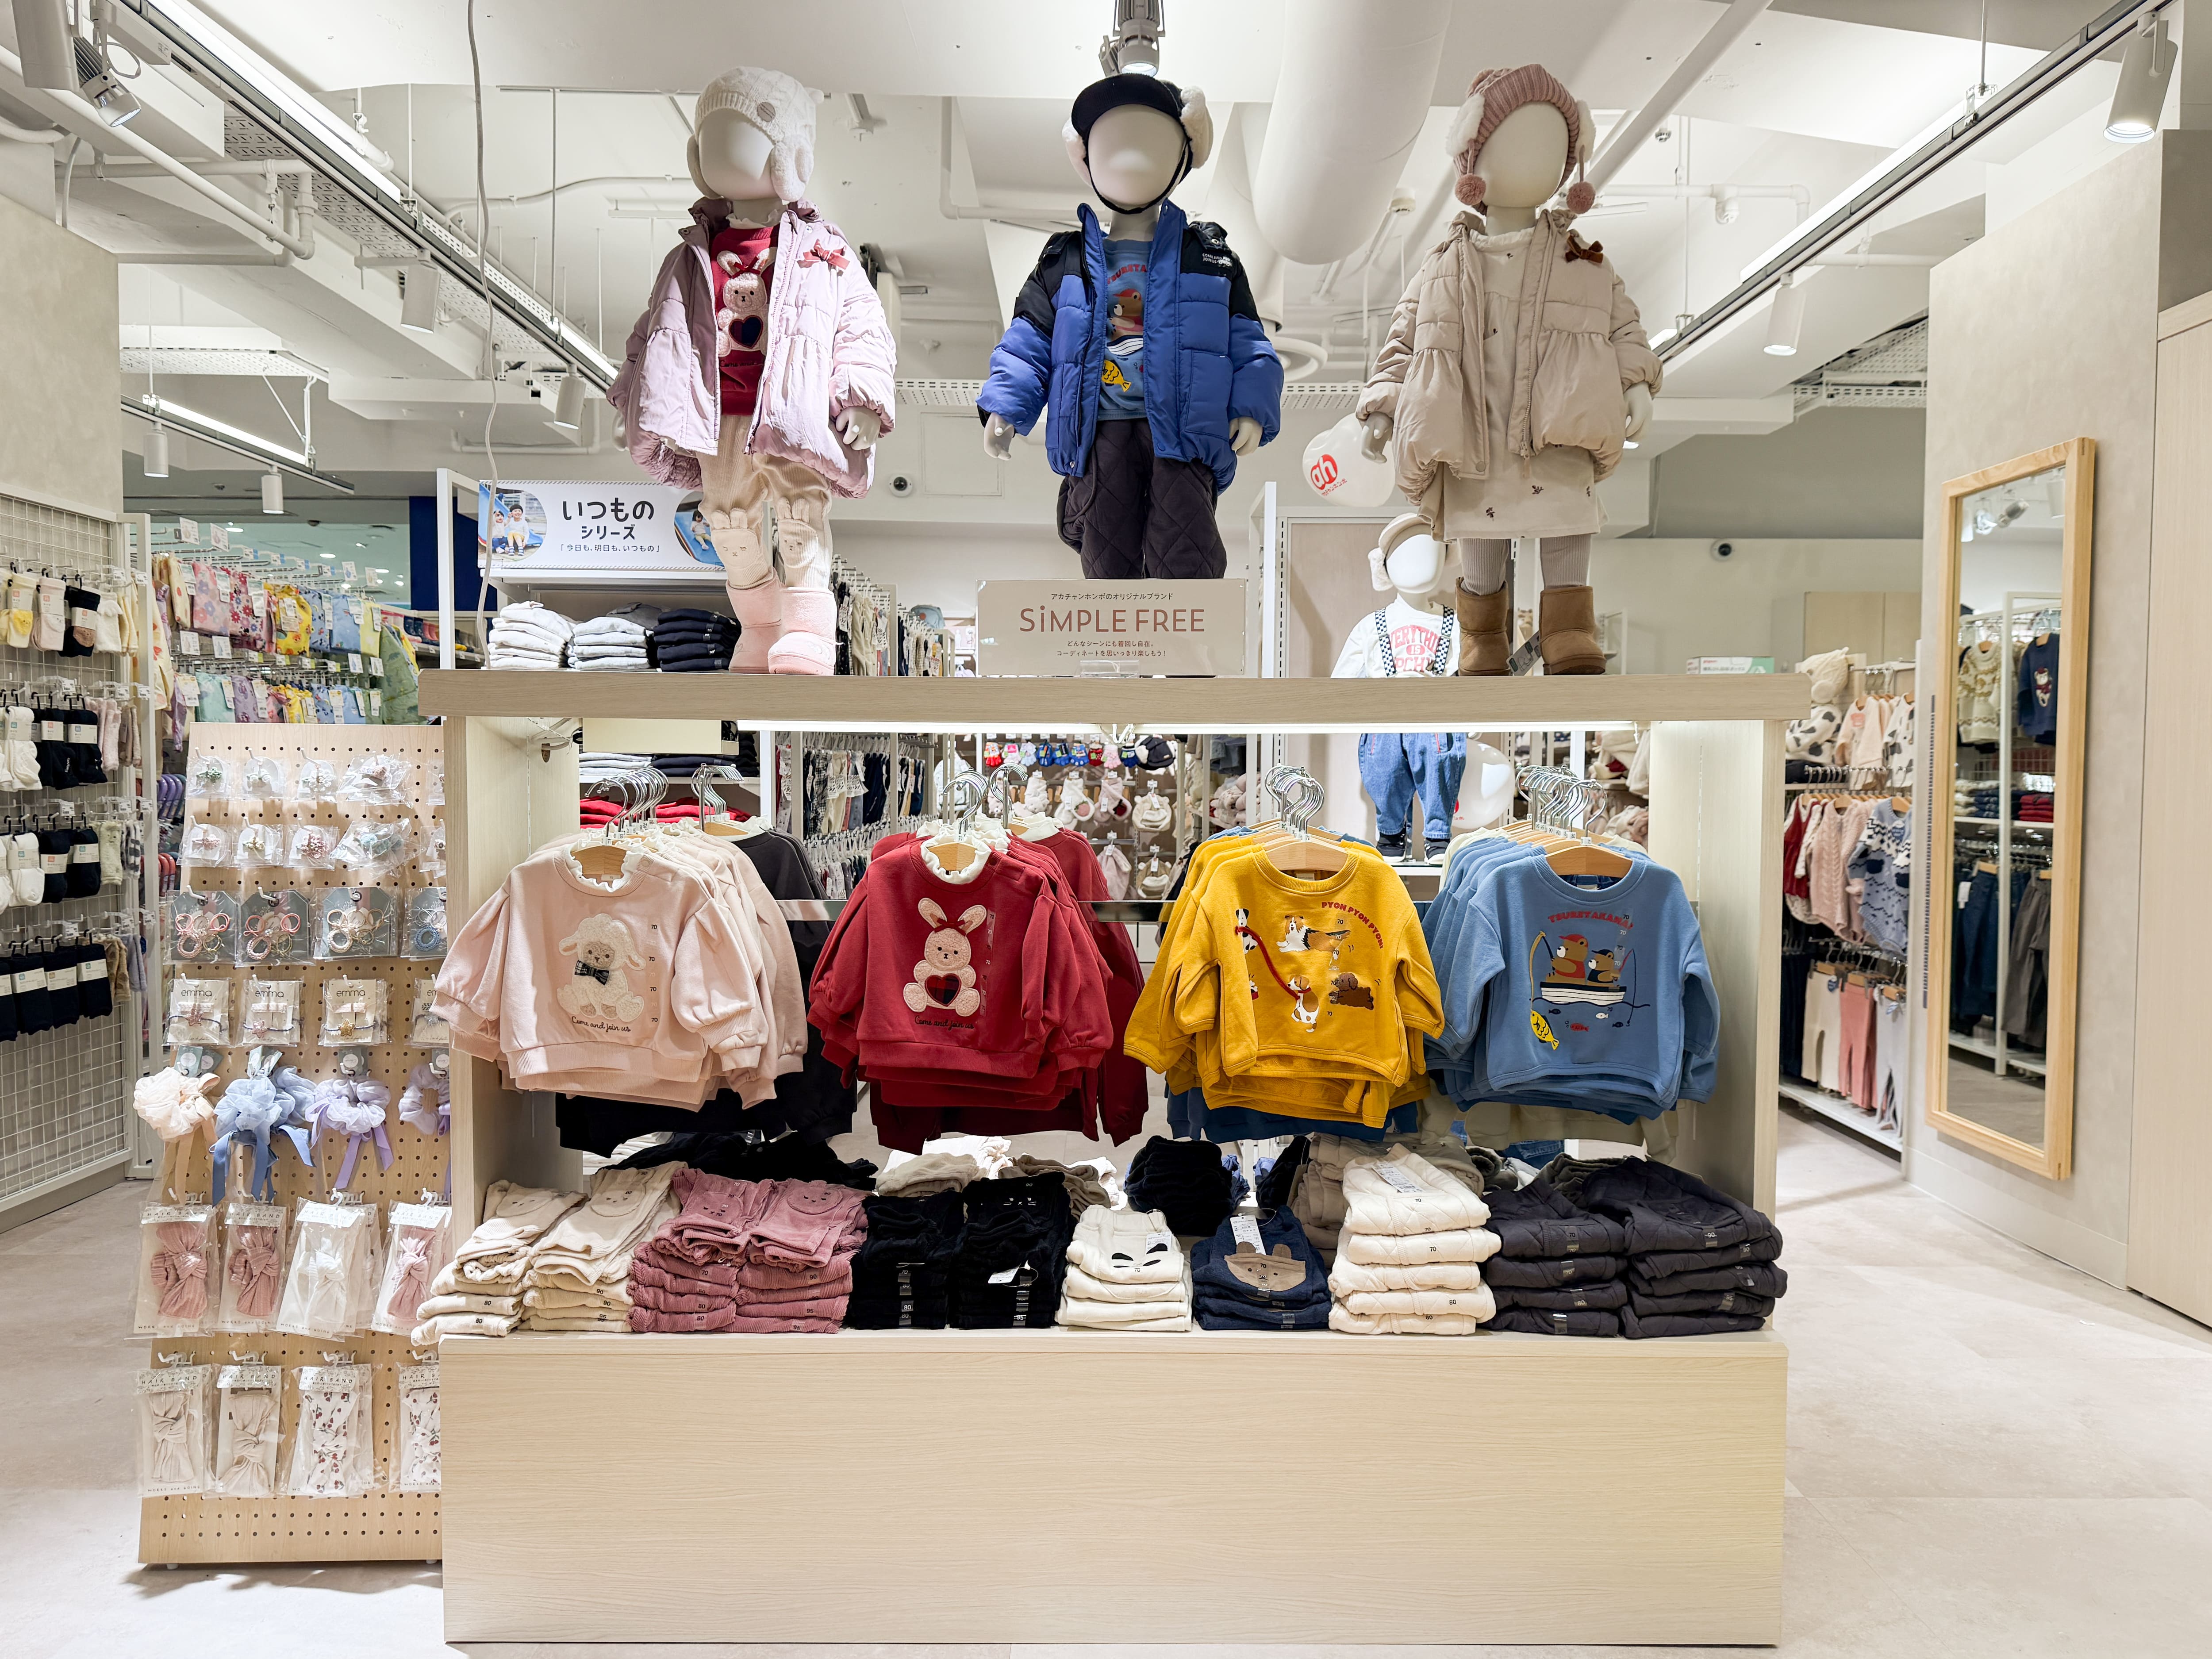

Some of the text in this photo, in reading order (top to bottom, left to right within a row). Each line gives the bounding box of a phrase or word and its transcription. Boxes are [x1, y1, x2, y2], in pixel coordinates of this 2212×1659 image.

[563, 497, 654, 522] いつもの
[581, 524, 635, 540] シリーズ
[561, 544, 659, 553] 「今日も、明日も、いつもの」
[1136, 609, 1204, 632] FREE
[1322, 902, 1347, 911] PYON
[1348, 906, 1370, 925] PYON
[572, 1016, 590, 1026] Come
[915, 1015, 932, 1025] Come
